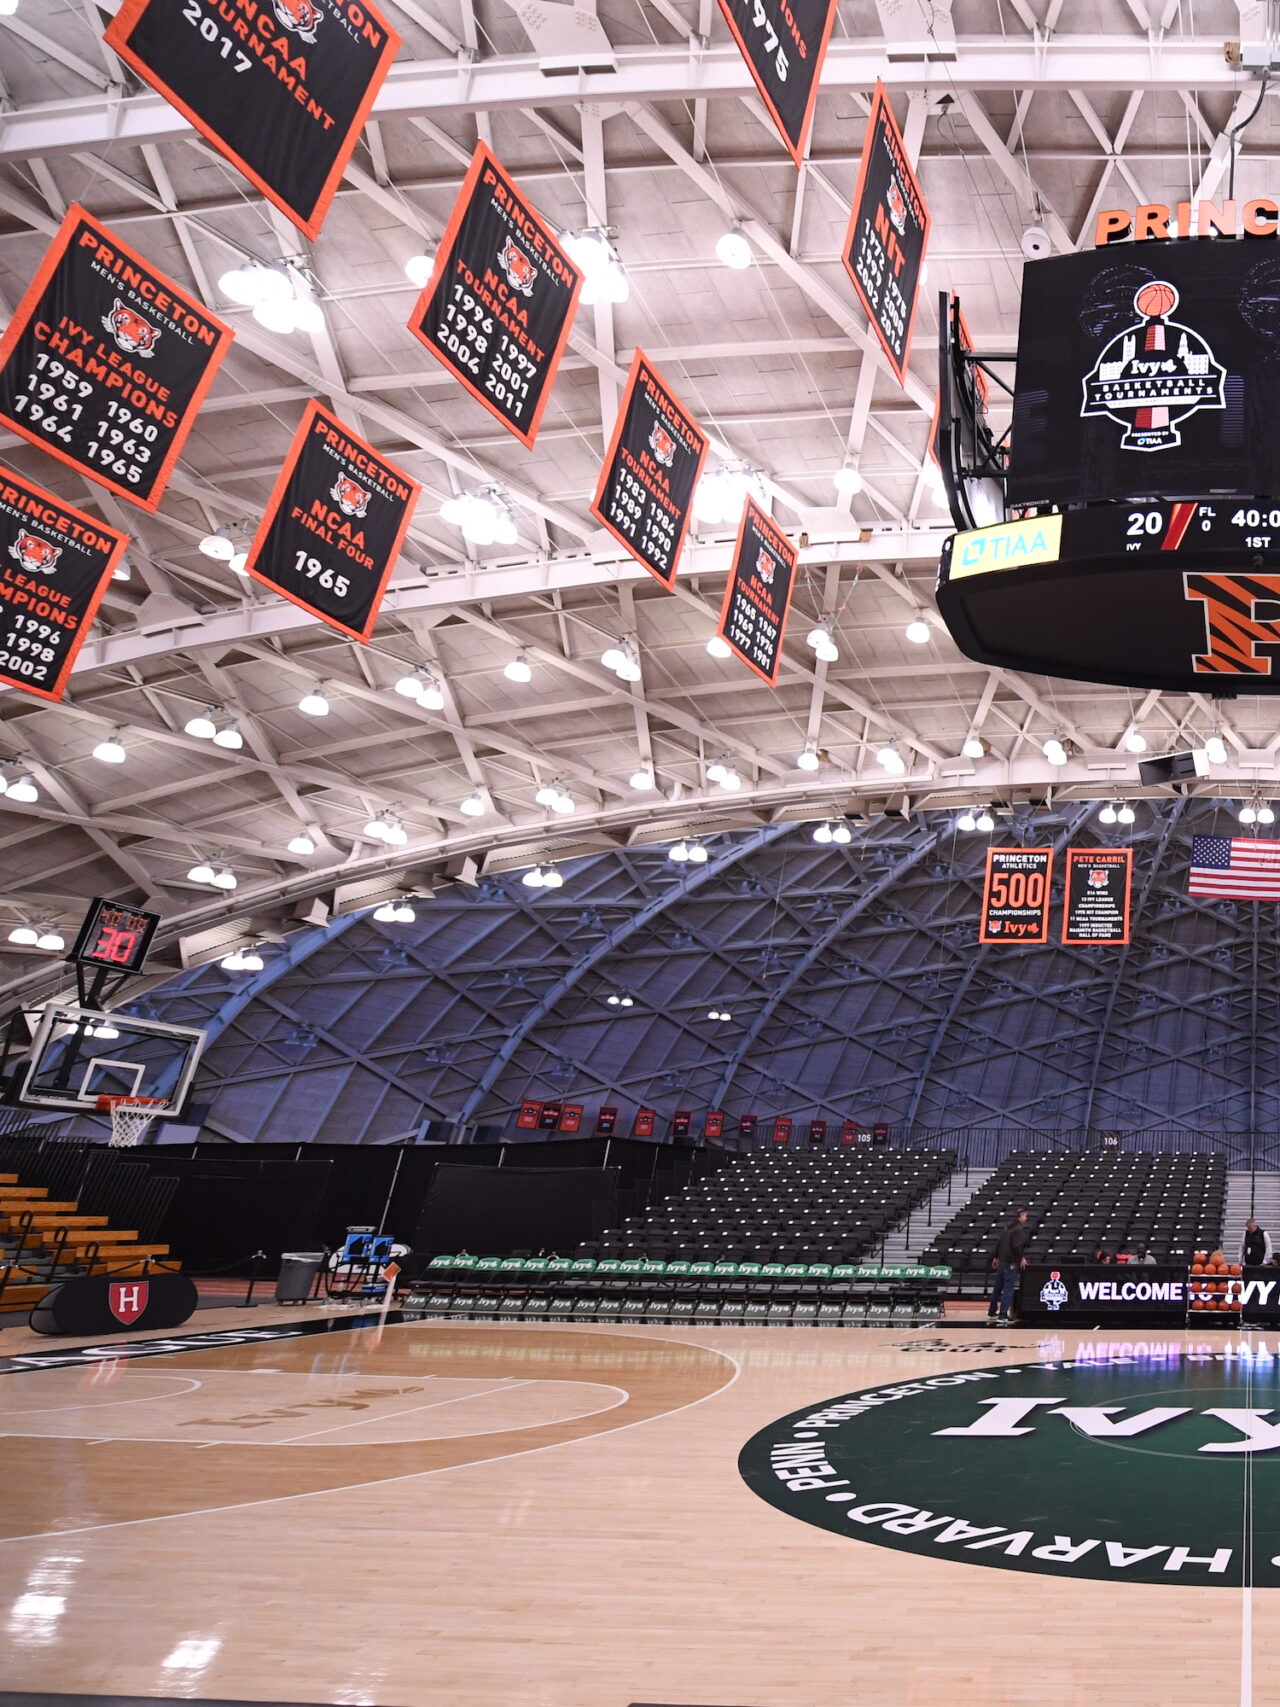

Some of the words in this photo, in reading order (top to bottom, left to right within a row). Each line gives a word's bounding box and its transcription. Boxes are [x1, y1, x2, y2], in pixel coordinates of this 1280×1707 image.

[182, 0, 252, 73] 2017
[236, 0, 307, 81] NCAA
[880, 107, 924, 231] PRINCETON
[483, 168, 574, 289] PRINCETON
[490, 197, 514, 230] MEN'S
[515, 228, 560, 287] BASKETBALL
[875, 202, 905, 277] NIT
[79, 231, 215, 346] PRINCETON
[484, 268, 529, 329] NCAA
[861, 239, 881, 287] 1999
[884, 293, 904, 337] 2000
[866, 219, 885, 271] 1972
[887, 273, 906, 318] 1975
[90, 260, 125, 291] MEN'S
[128, 290, 194, 345] BASKETBALL
[453, 284, 494, 335] 1996
[500, 335, 538, 380] 1997
[457, 258, 546, 363] TOURNAMENT
[856, 260, 878, 310] 2002
[881, 312, 901, 356] 2016
[33, 321, 179, 429] CHAMPIONS
[58, 315, 94, 346] IVY
[99, 343, 171, 403] LEAGUE
[437, 323, 480, 376] 2004
[485, 374, 523, 418] 2011
[446, 304, 488, 354] 1998
[492, 354, 529, 400] 2001
[1130, 358, 1160, 377] Ivy
[36, 353, 93, 398] 1959
[107, 400, 158, 443] 1960
[640, 369, 703, 456] PRINCETON
[1094, 387, 1213, 401] TOURNAMENTS
[1102, 379, 1205, 392] BASKETBALL
[14, 395, 75, 443] 1964
[87, 441, 142, 484] 1965
[27, 374, 83, 420] 1961
[97, 420, 151, 463] 1963
[315, 420, 409, 501] PRINCETON
[323, 443, 346, 466] MEN'S
[348, 463, 394, 502] BASKETBALL
[621, 447, 682, 522] TOURNAMENT
[640, 450, 670, 494] NCAA
[312, 499, 365, 550] NCAA
[615, 485, 642, 520] 1989
[645, 519, 672, 552] 1990
[619, 468, 646, 505] 1983
[650, 503, 675, 537] 1984
[1126, 512, 1163, 535] 20
[1199, 506, 1216, 517] FL
[1202, 520, 1211, 532] 0
[31, 520, 92, 556] BASKETBALL
[291, 506, 333, 545] FINAL
[337, 539, 375, 571] FOUR
[610, 502, 636, 538] 1991
[641, 535, 668, 570] 1992
[749, 506, 794, 567] PRINCETON
[989, 530, 1048, 560] TIAA
[1126, 542, 1142, 551] IVY
[1245, 536, 1271, 548] 1ST
[3, 568, 72, 608] LEAGUE
[294, 550, 351, 598] 1965
[737, 577, 780, 627] TOURNAMENT
[750, 574, 773, 606] NCAA
[14, 614, 61, 645] 1996
[733, 610, 753, 635] 1969
[756, 632, 774, 656] 1976
[736, 594, 756, 621] 1965
[758, 617, 777, 641] 1967
[0, 652, 48, 682] 2002
[6, 633, 56, 663] 1998
[730, 625, 751, 650] 1977
[753, 646, 771, 671] 1981
[993, 854, 1047, 863] PRINCETON
[991, 872, 1044, 908] 500
[92, 927, 137, 963] 30
[1003, 920, 1028, 936] Ivy
[857, 1133, 871, 1143] 105
[119, 1285, 140, 1313] H
[1079, 1281, 1183, 1301] WELCOME
[792, 1370, 1002, 1429] PRINCETON
[770, 1441, 850, 1492] PENN
[847, 1502, 1234, 1573] HARVARD
